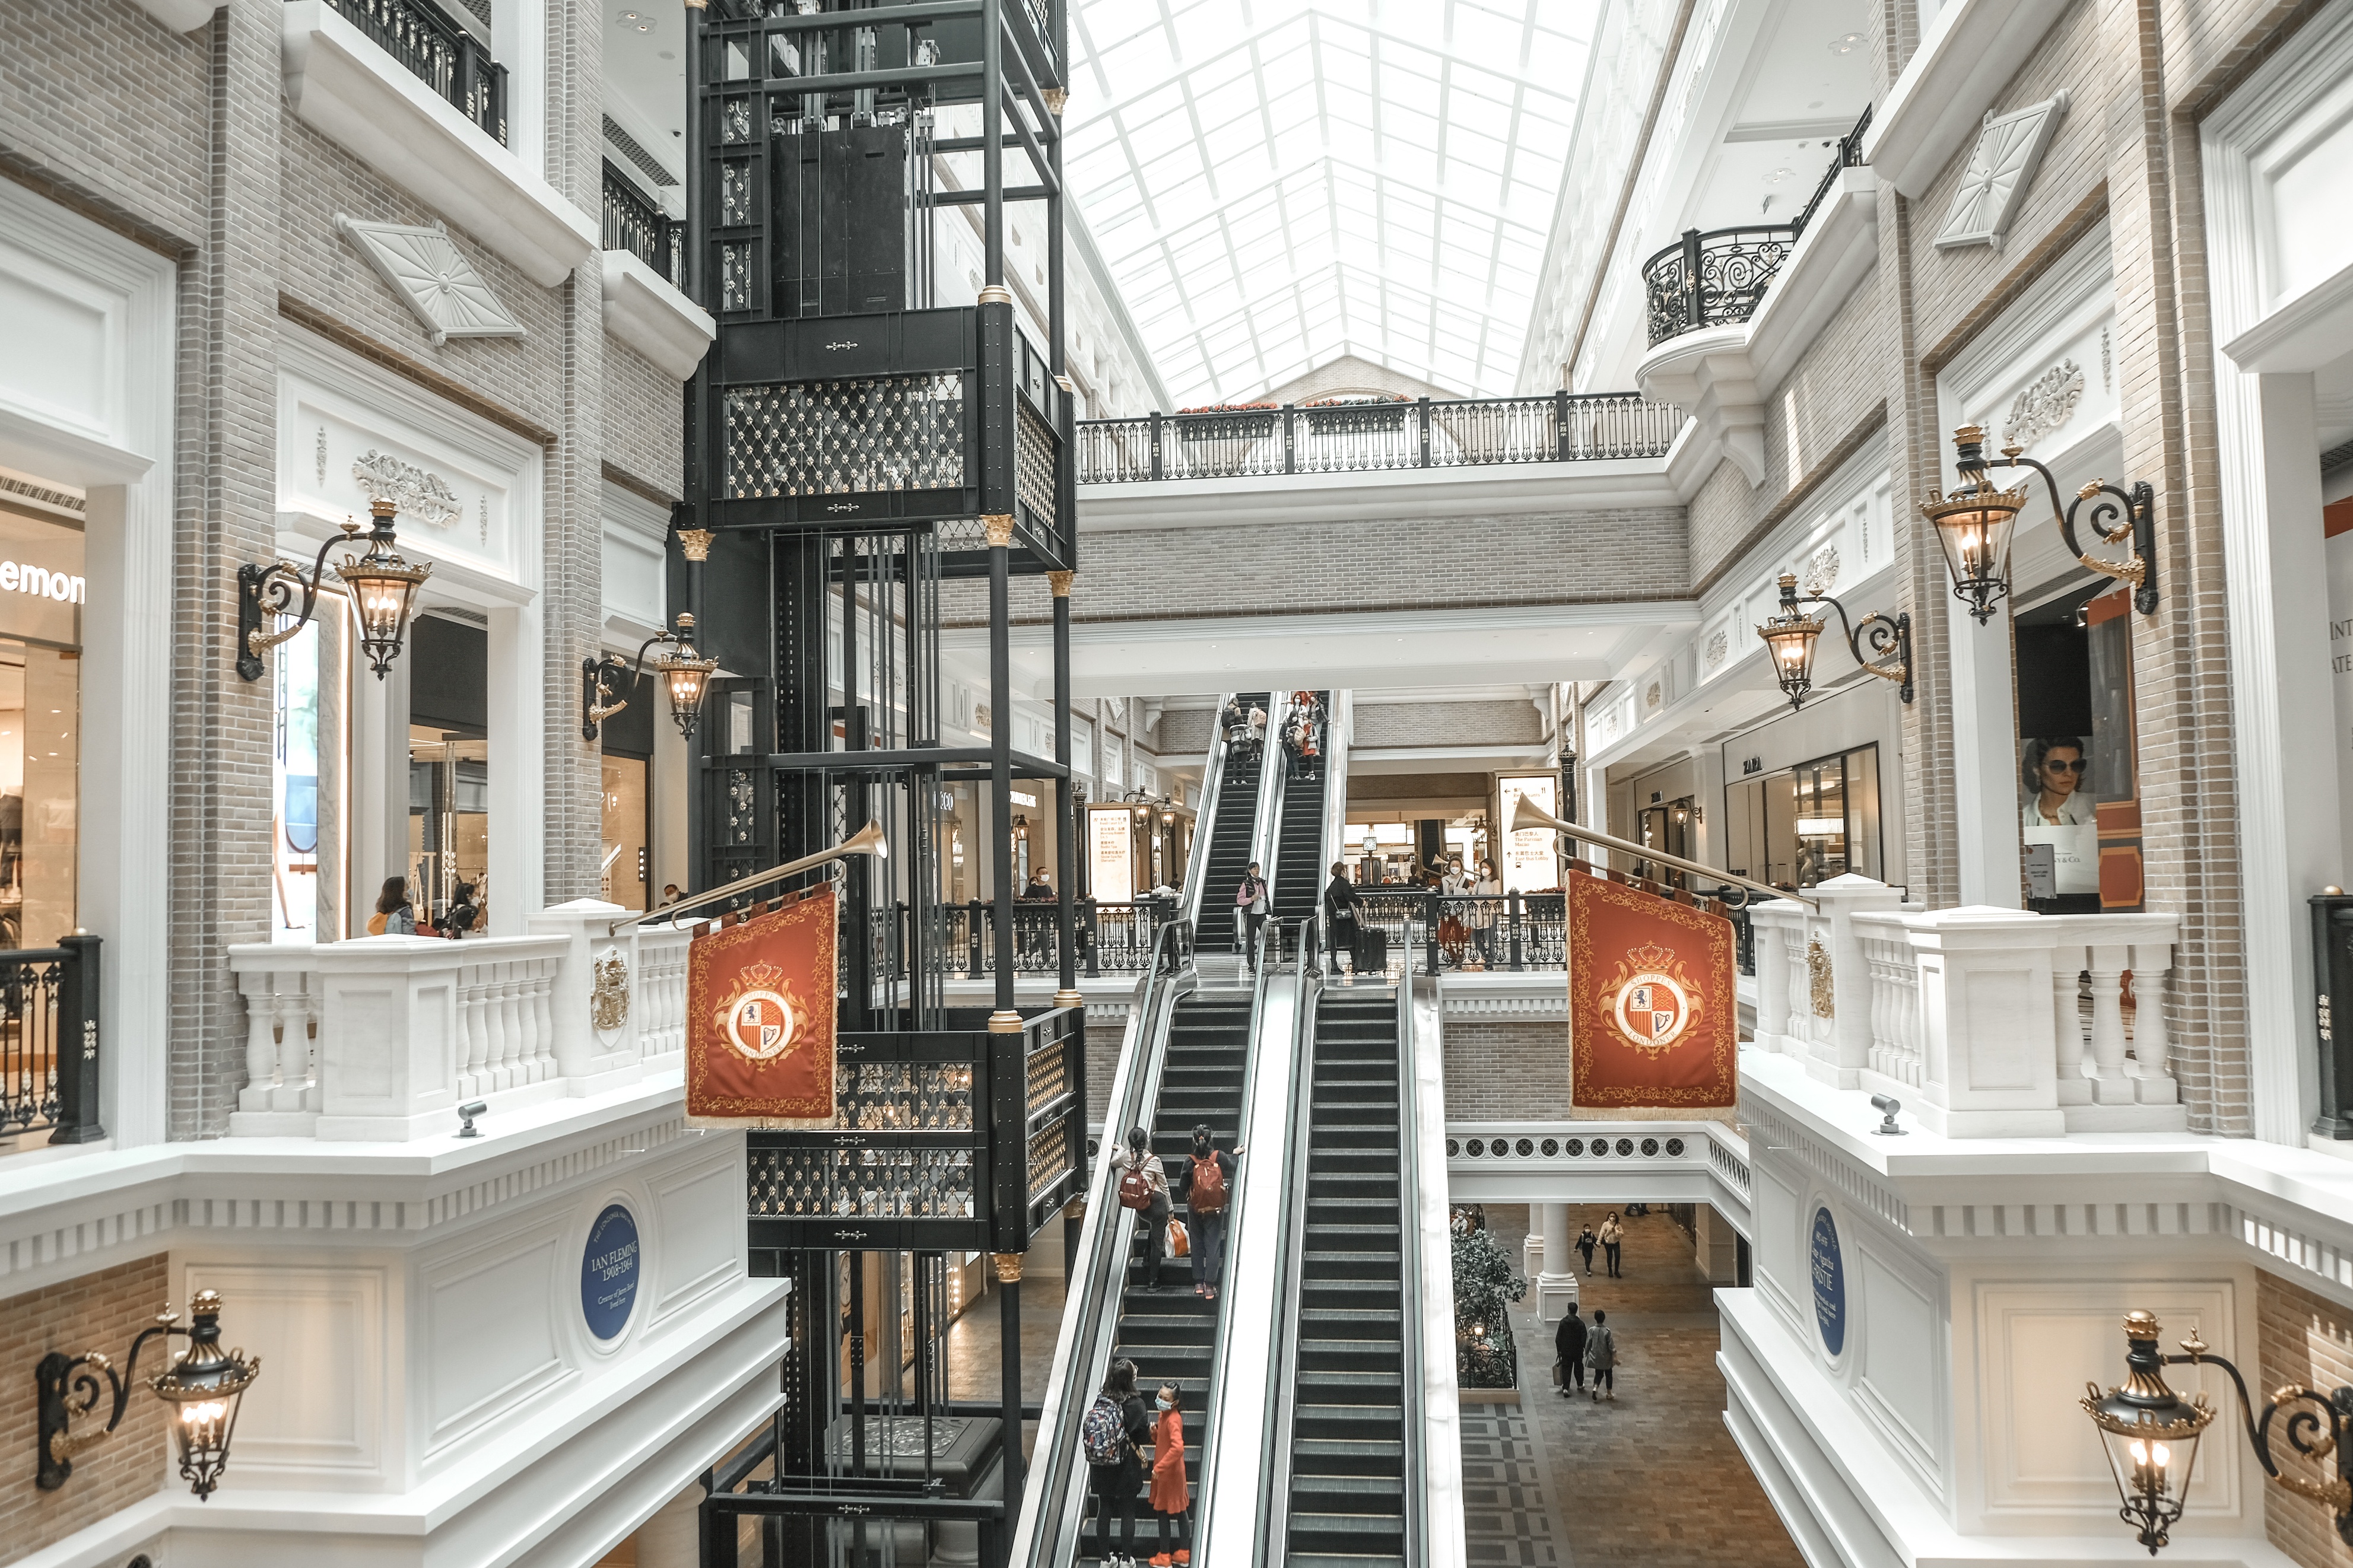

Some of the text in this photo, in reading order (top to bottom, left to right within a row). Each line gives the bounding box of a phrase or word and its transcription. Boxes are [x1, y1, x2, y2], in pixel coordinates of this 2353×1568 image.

[1631, 975, 1672, 986] SHOPPES
[743, 991, 780, 1003] SHOPPES
[1628, 1031, 1677, 1045] LONDONER
[739, 1044, 783, 1058] LONDONER
[593, 1229, 602, 1243] THE
[592, 1240, 637, 1272] IAN FLEMING
[603, 1255, 633, 1281] 1908-1964
[598, 1294, 614, 1305] Creator
